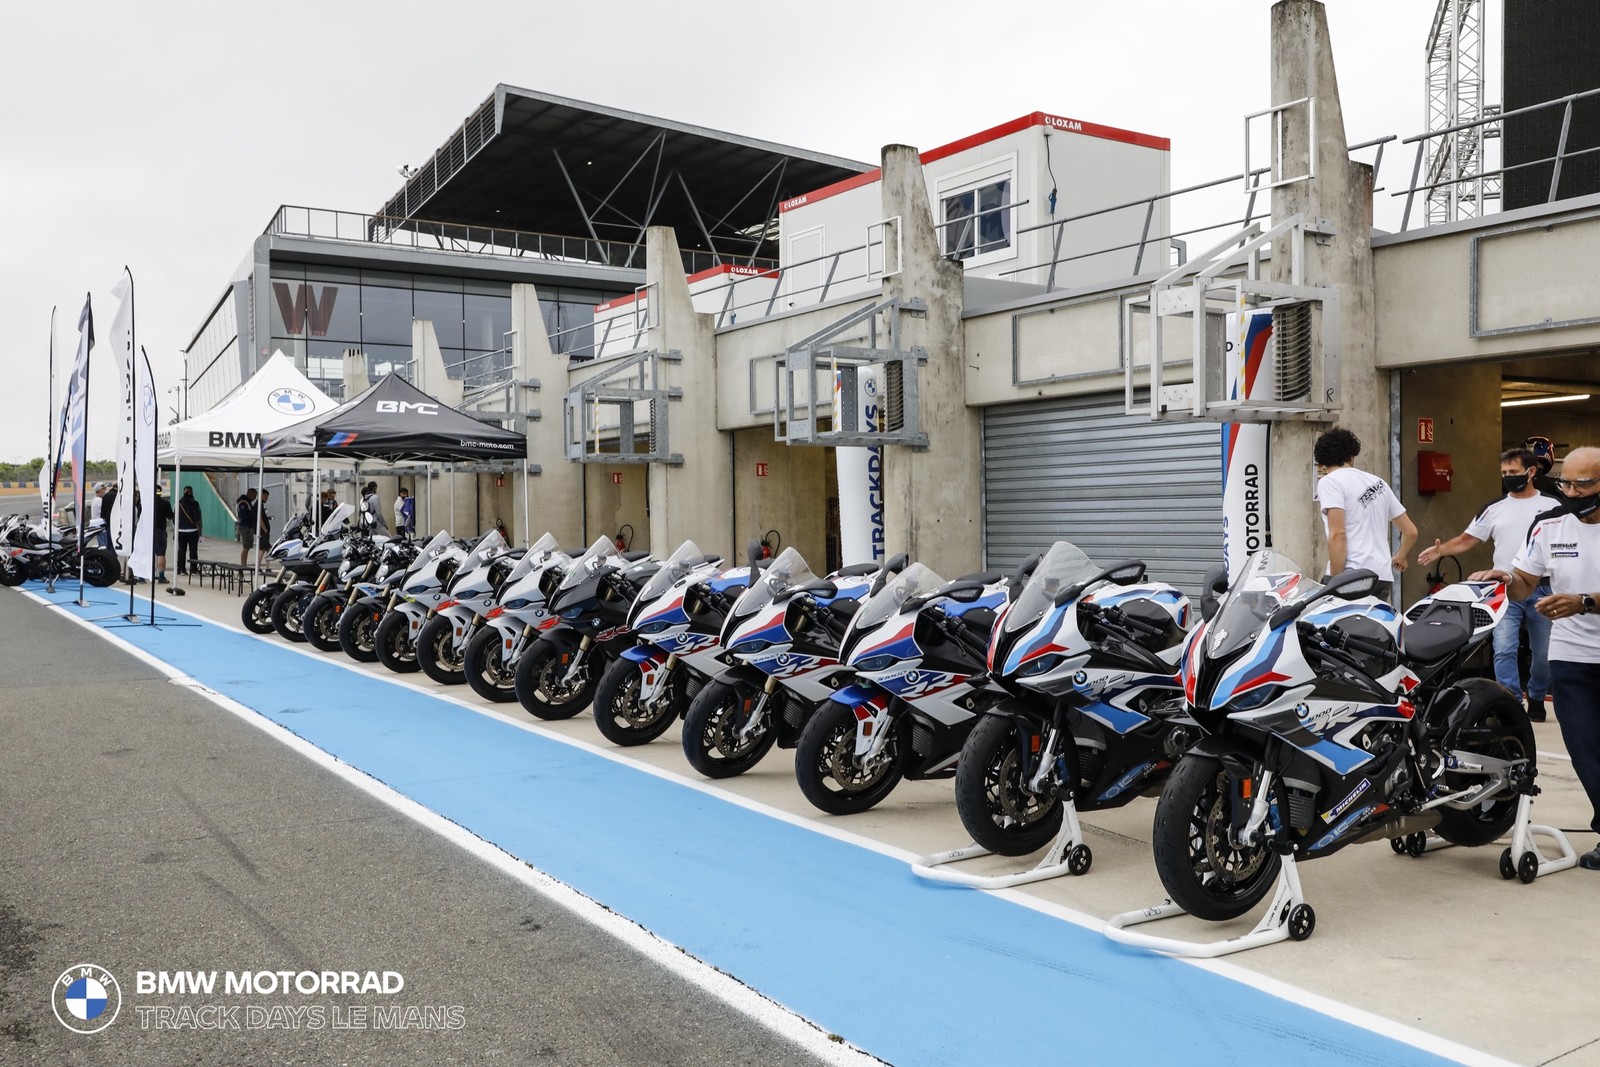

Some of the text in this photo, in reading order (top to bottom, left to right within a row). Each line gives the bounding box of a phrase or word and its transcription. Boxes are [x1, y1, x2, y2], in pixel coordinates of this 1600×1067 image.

[1052, 117, 1082, 131] LOXAM
[375, 400, 439, 416] BMC
[208, 431, 264, 449] BMW
[460, 439, 515, 450] bmc-moto.com
[1336, 780, 1368, 813] MICHELIN
